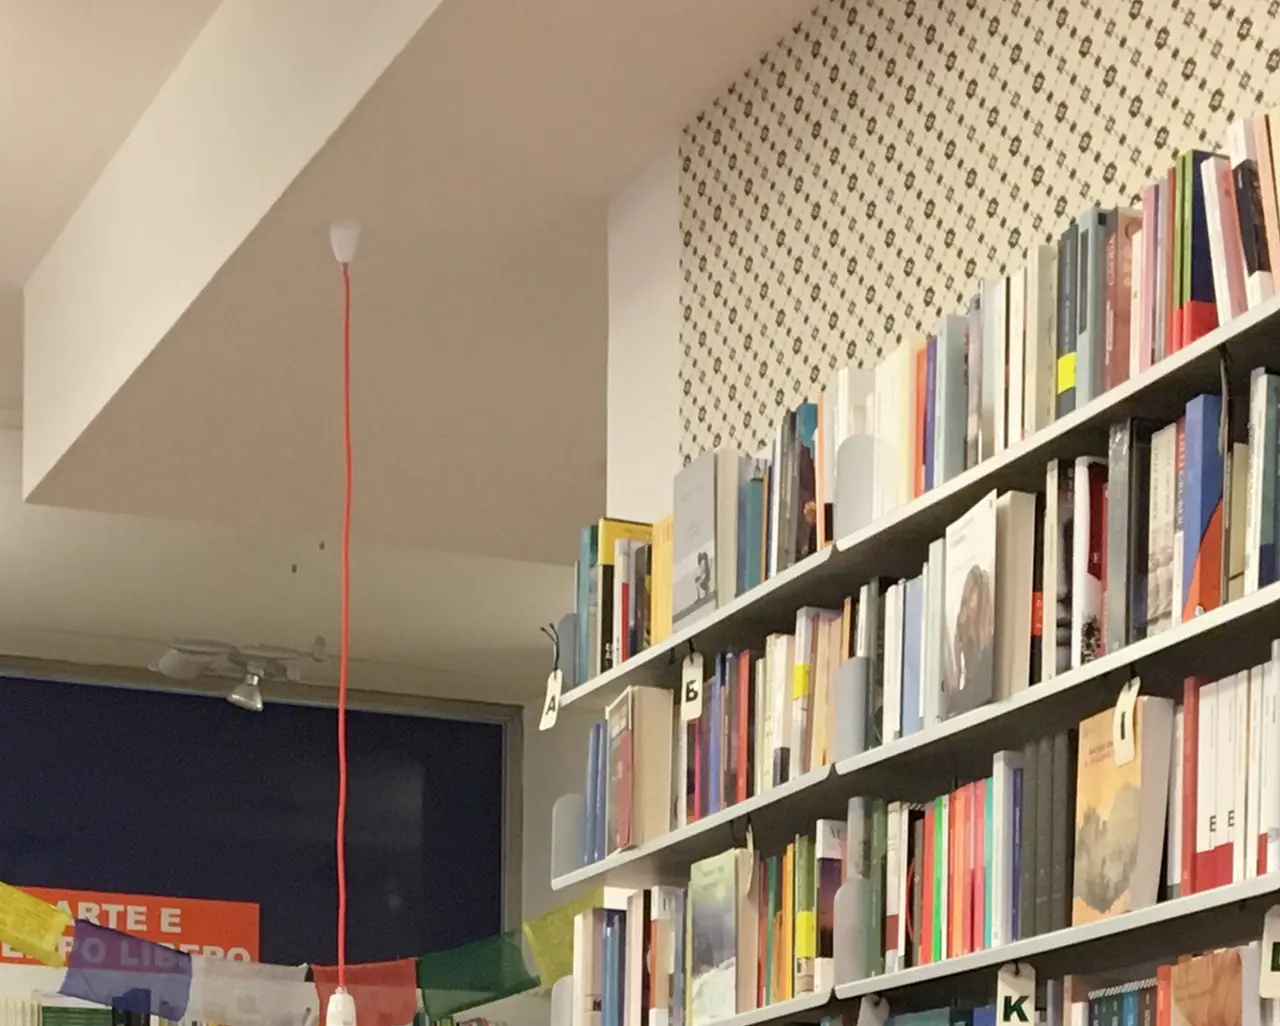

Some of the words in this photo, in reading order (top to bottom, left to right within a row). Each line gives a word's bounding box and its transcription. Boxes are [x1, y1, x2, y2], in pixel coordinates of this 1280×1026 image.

[545, 695, 556, 716] A
[54, 900, 148, 932] ARTE
[160, 908, 182, 933] E
[1002, 995, 1029, 1022] K
